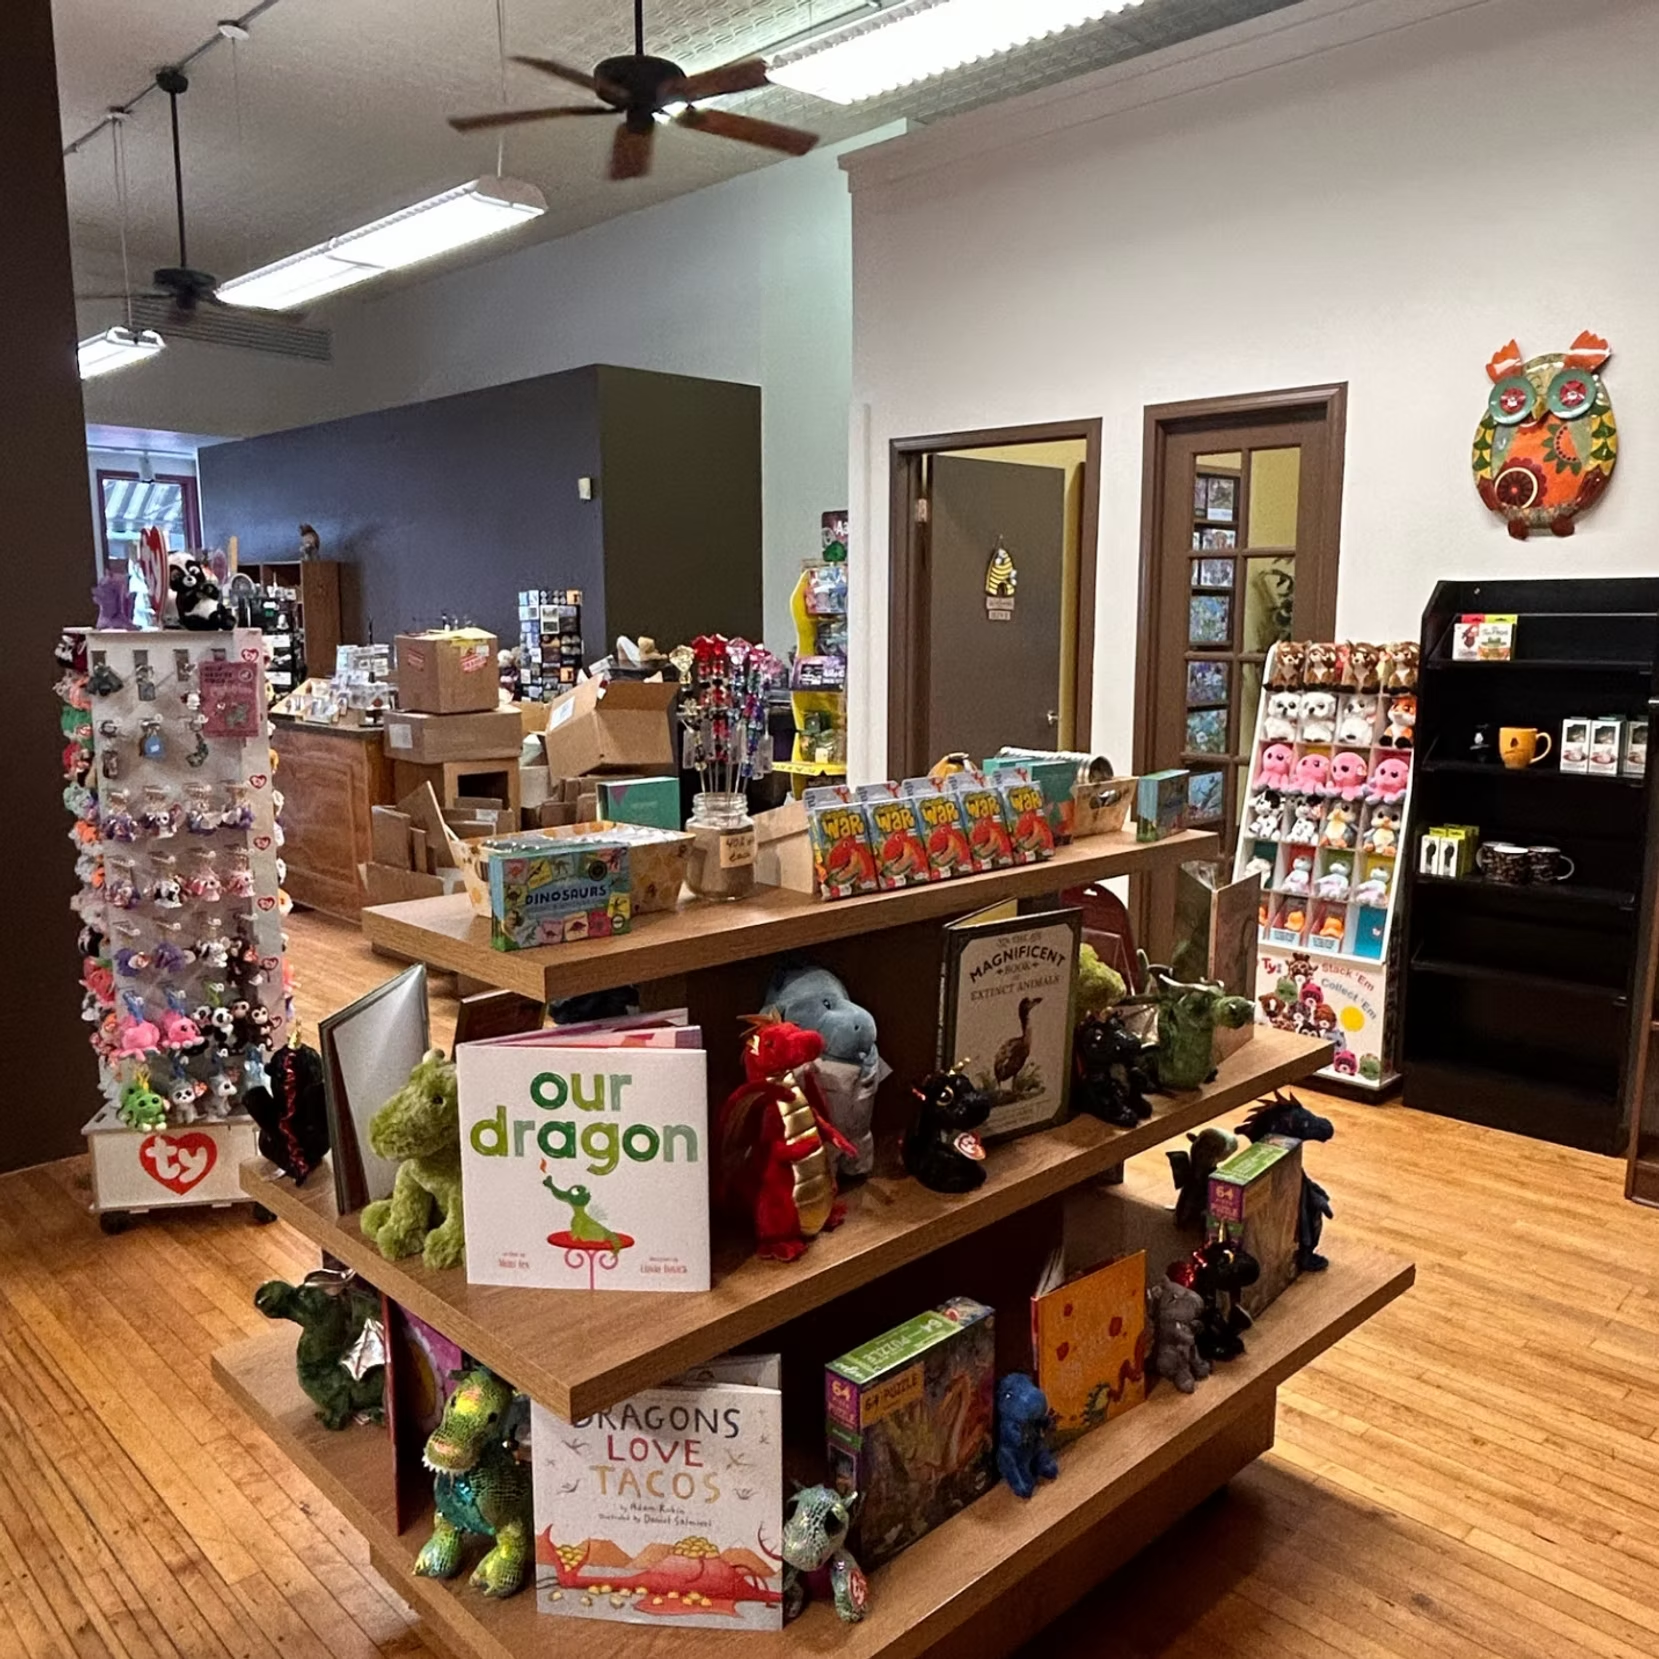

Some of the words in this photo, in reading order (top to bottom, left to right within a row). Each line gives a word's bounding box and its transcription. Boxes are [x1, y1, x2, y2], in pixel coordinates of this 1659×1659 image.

[525, 885, 607, 905] DINOSAURS
[969, 945, 1066, 984] MAGNIFICENT
[1321, 961, 1352, 978] Stack
[970, 983, 1015, 1001] EXTINCT
[1016, 975, 1061, 993] ANIMALS
[1321, 977, 1359, 1002] Collect
[530, 1072, 632, 1112] our
[470, 1105, 698, 1176] dragon
[146, 1137, 208, 1183] ty
[832, 1380, 851, 1401] 64
[573, 1403, 741, 1439] RAGONS
[607, 1434, 704, 1468] LOVE
[589, 1465, 721, 1504] TACOS
